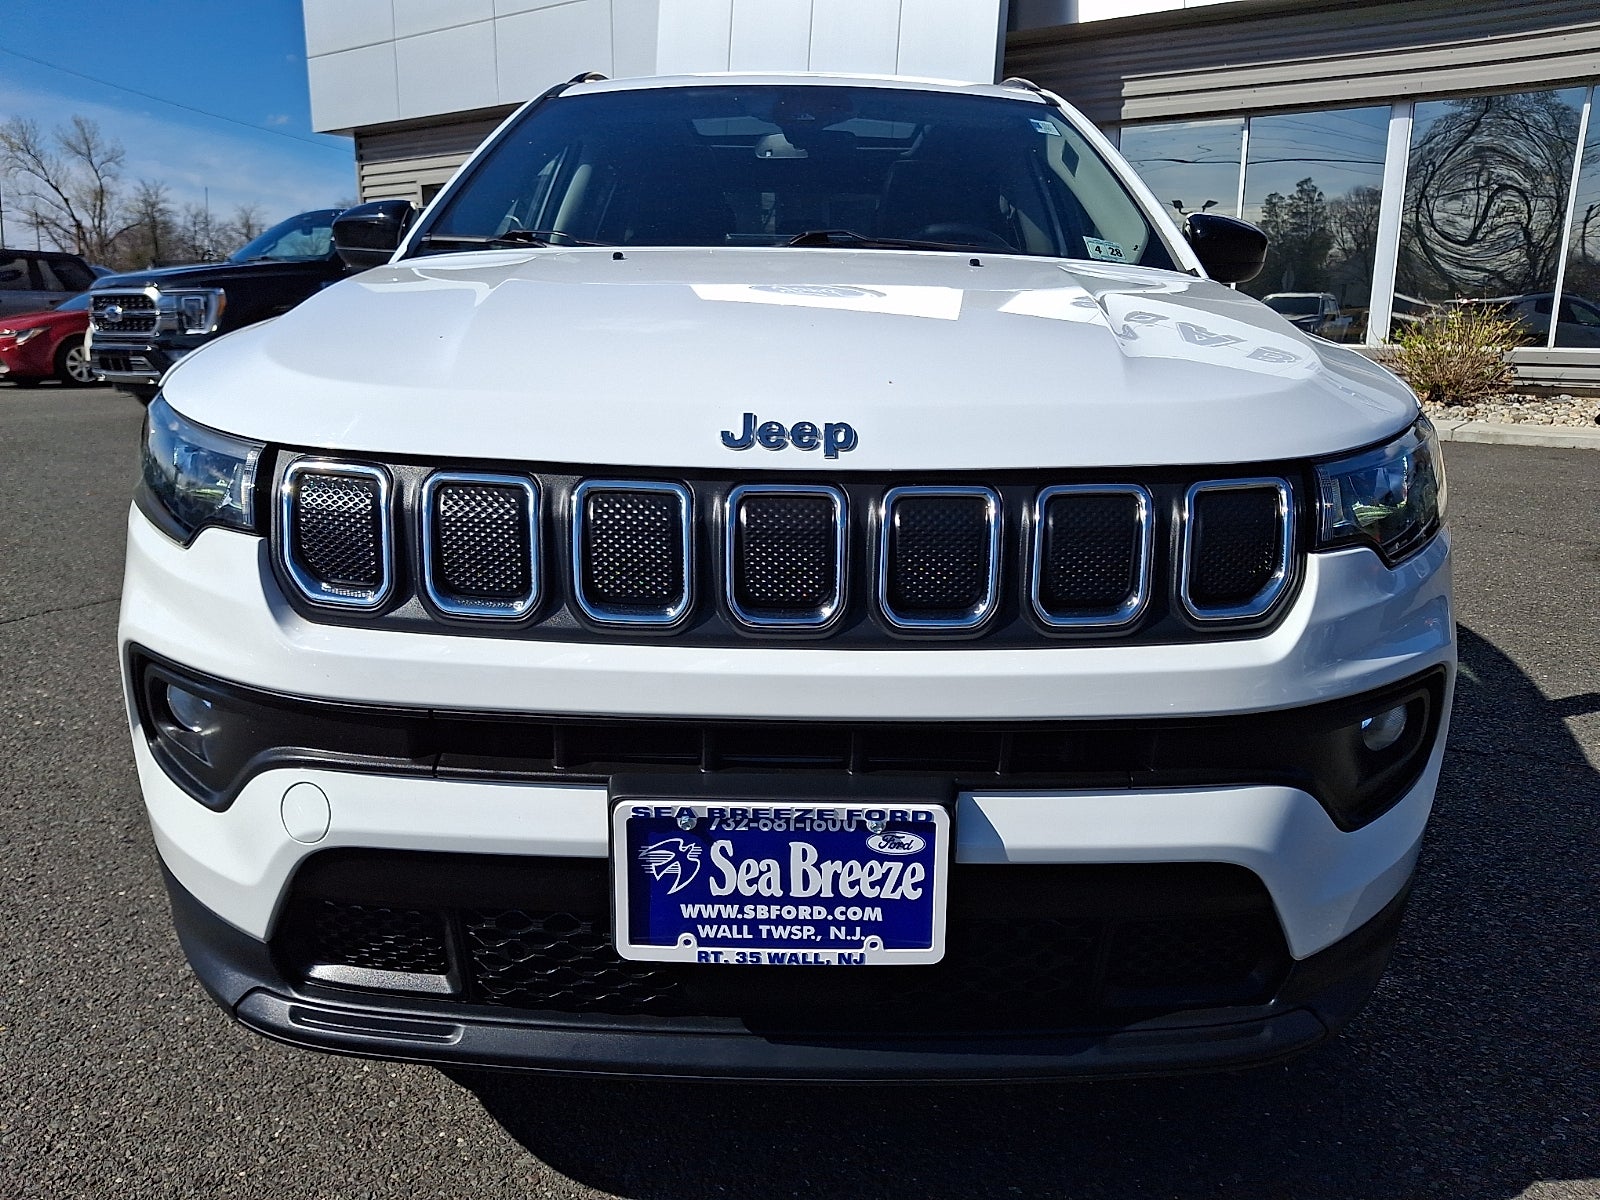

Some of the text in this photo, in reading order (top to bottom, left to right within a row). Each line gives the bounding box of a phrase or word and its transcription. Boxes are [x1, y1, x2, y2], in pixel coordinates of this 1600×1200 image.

[1095, 246, 1102, 255] 4
[1108, 247, 1123, 257] 28
[720, 412, 858, 459] Jeep
[631, 805, 935, 823] SEA BREEZE FORD
[878, 834, 914, 851] Ford
[709, 839, 926, 900] Sea Breeze
[680, 903, 883, 921] WWW.SBFORD.COM
[697, 924, 866, 941] WALL TWSP., N.J.
[697, 950, 866, 965] RT. 35 WALL, NJ
